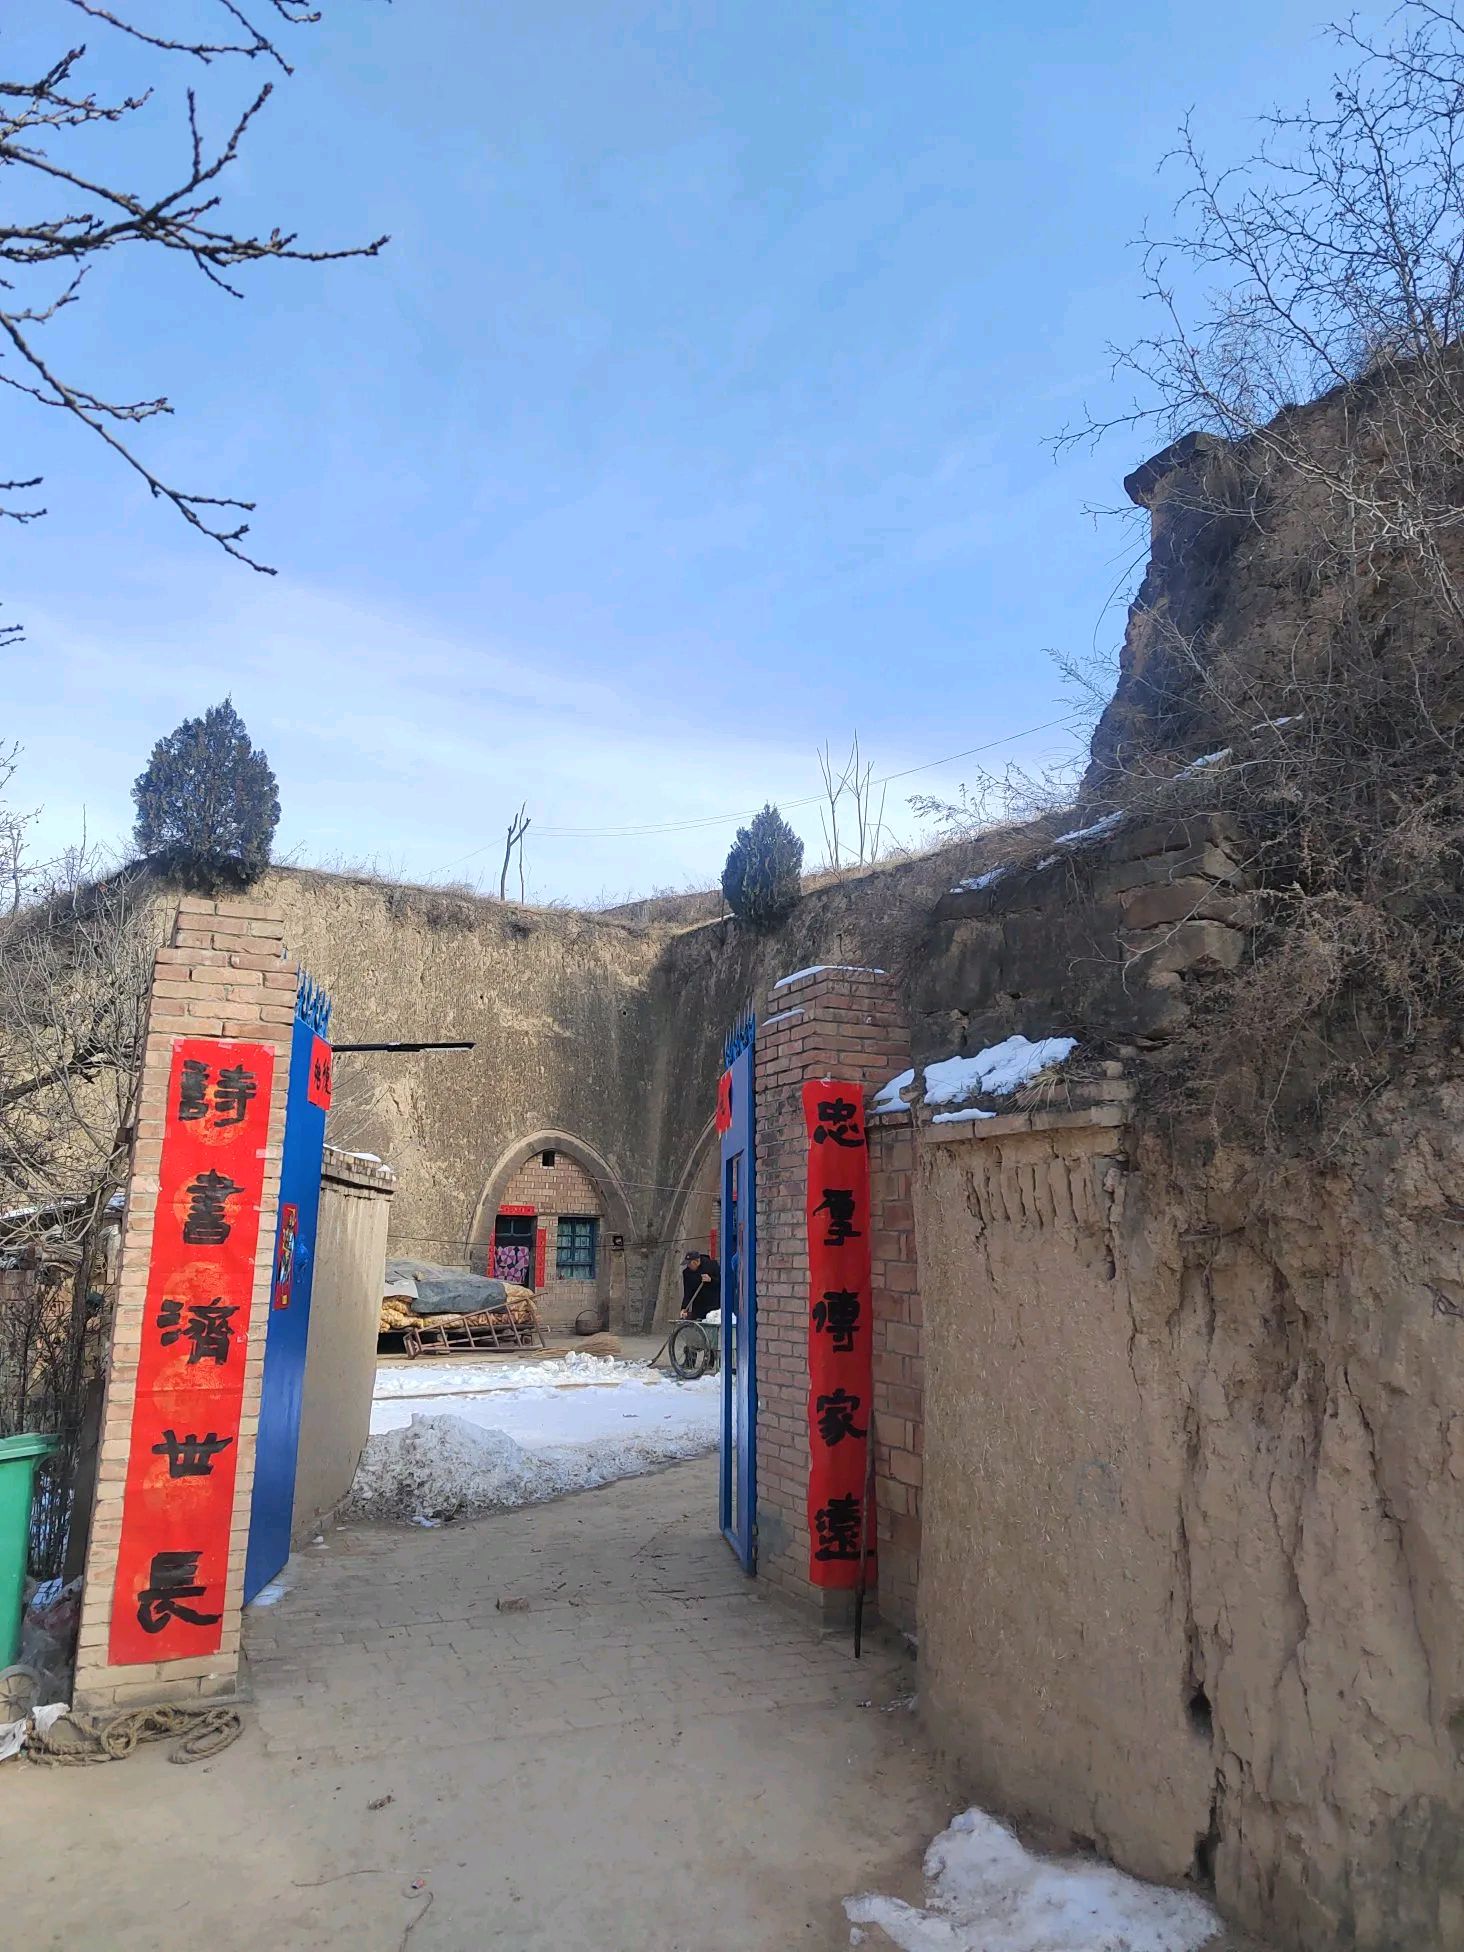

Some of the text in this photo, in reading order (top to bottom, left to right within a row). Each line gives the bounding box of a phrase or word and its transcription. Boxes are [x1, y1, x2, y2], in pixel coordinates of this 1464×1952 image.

[137, 1059, 257, 1635] 詩書濟世長
[812, 1098, 875, 1562] 忠厚傳家遠
